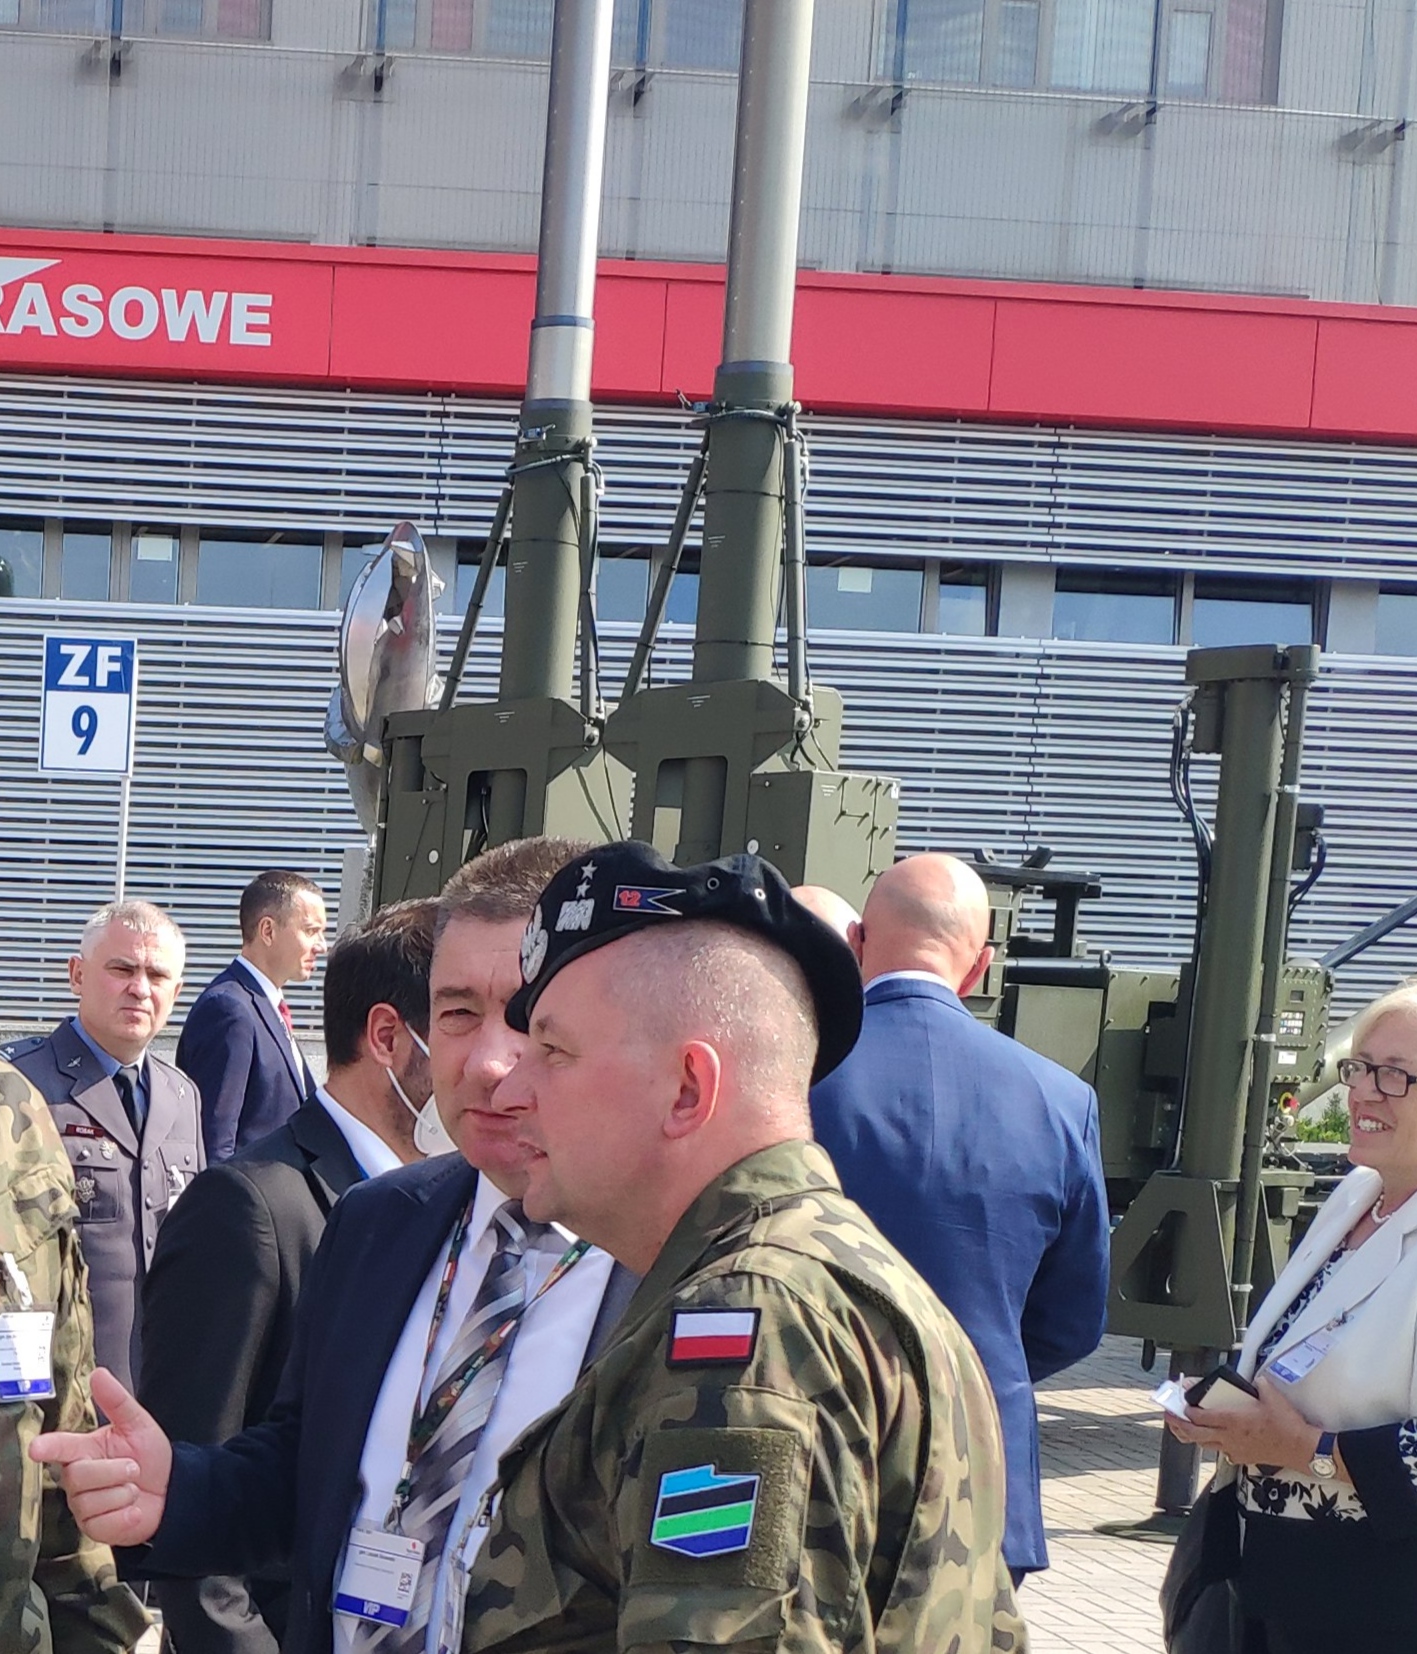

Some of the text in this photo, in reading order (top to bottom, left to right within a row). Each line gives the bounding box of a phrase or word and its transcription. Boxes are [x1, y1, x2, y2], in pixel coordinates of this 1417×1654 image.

[57, 643, 122, 688] ZF
[71, 704, 99, 756] 9
[618, 890, 642, 907] 12
[363, 1601, 380, 1616] VIP
